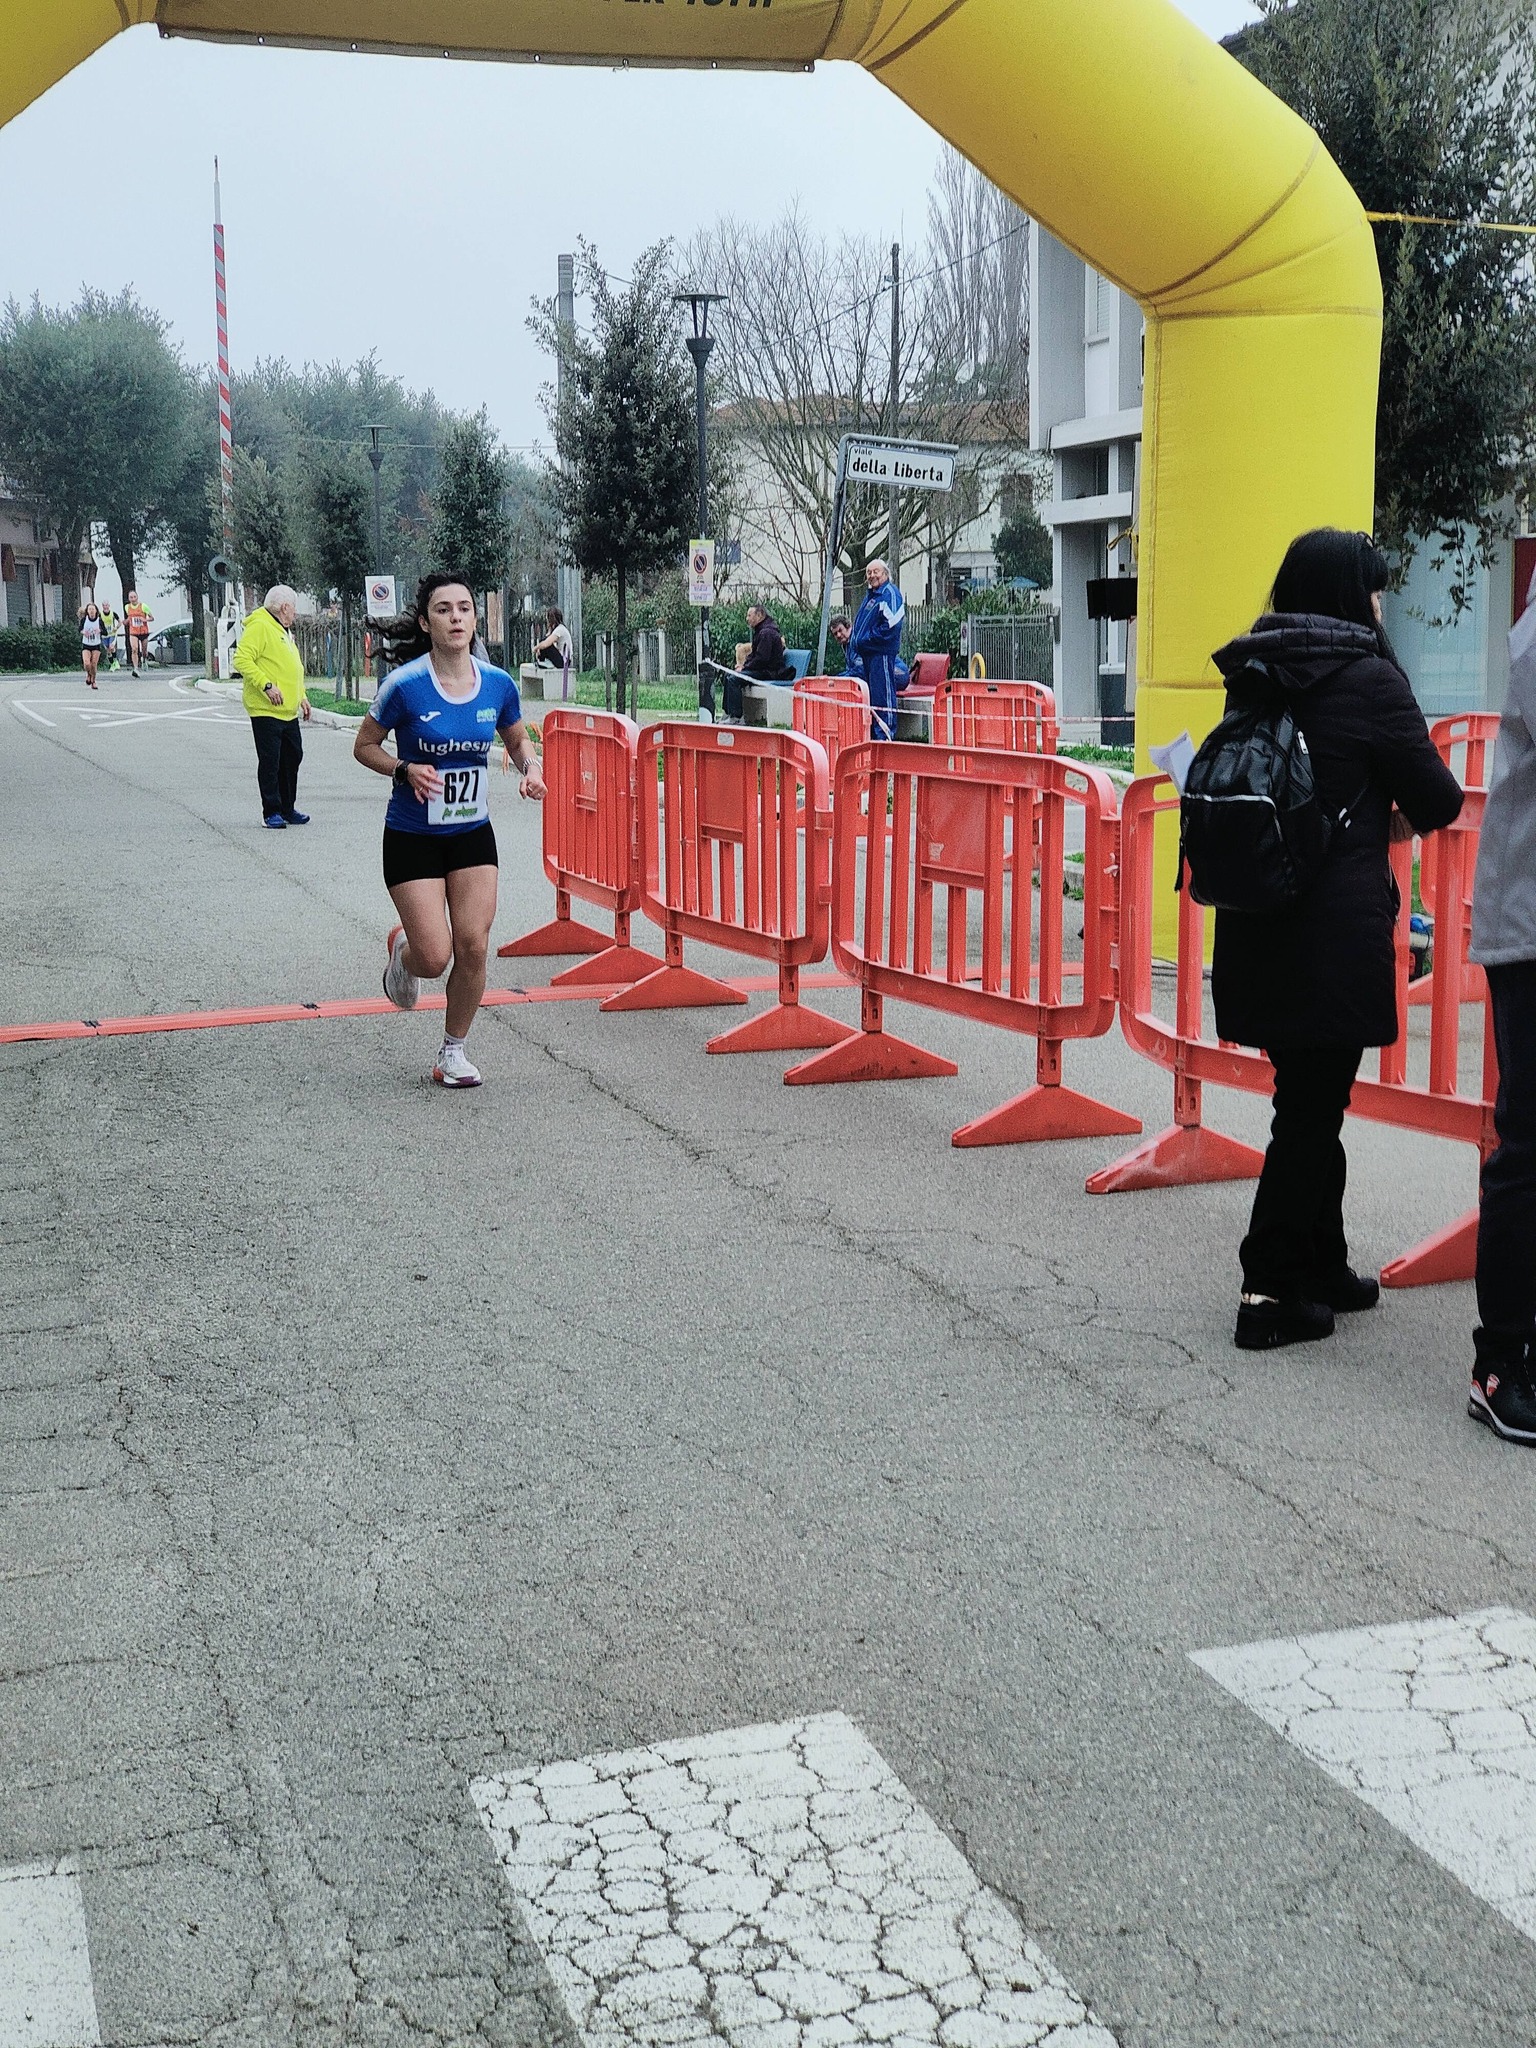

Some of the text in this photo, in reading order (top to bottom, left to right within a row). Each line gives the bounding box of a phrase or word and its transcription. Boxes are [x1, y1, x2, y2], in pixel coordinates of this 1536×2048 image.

[854, 448, 873, 456] viale
[852, 457, 887, 475] della
[444, 769, 480, 805] 627
